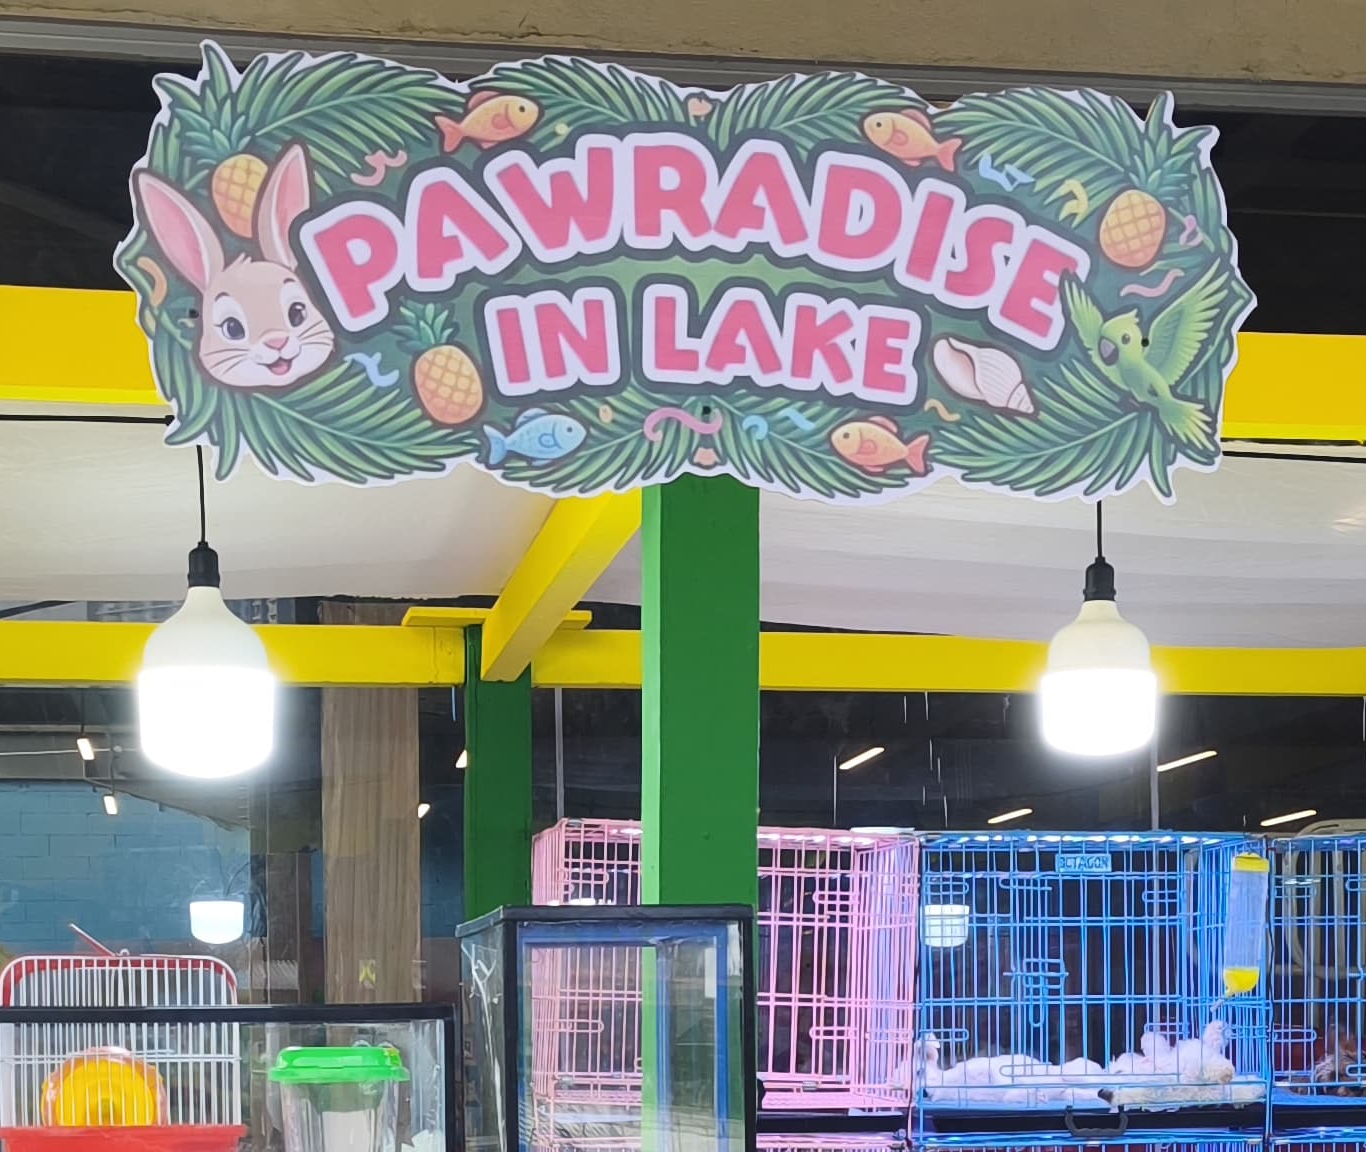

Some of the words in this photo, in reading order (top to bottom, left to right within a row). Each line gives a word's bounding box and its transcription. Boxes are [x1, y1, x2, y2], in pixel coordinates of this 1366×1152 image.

[305, 136, 1093, 344] PAWRADISE
[489, 295, 615, 390] IN
[649, 292, 920, 399] LAKE
